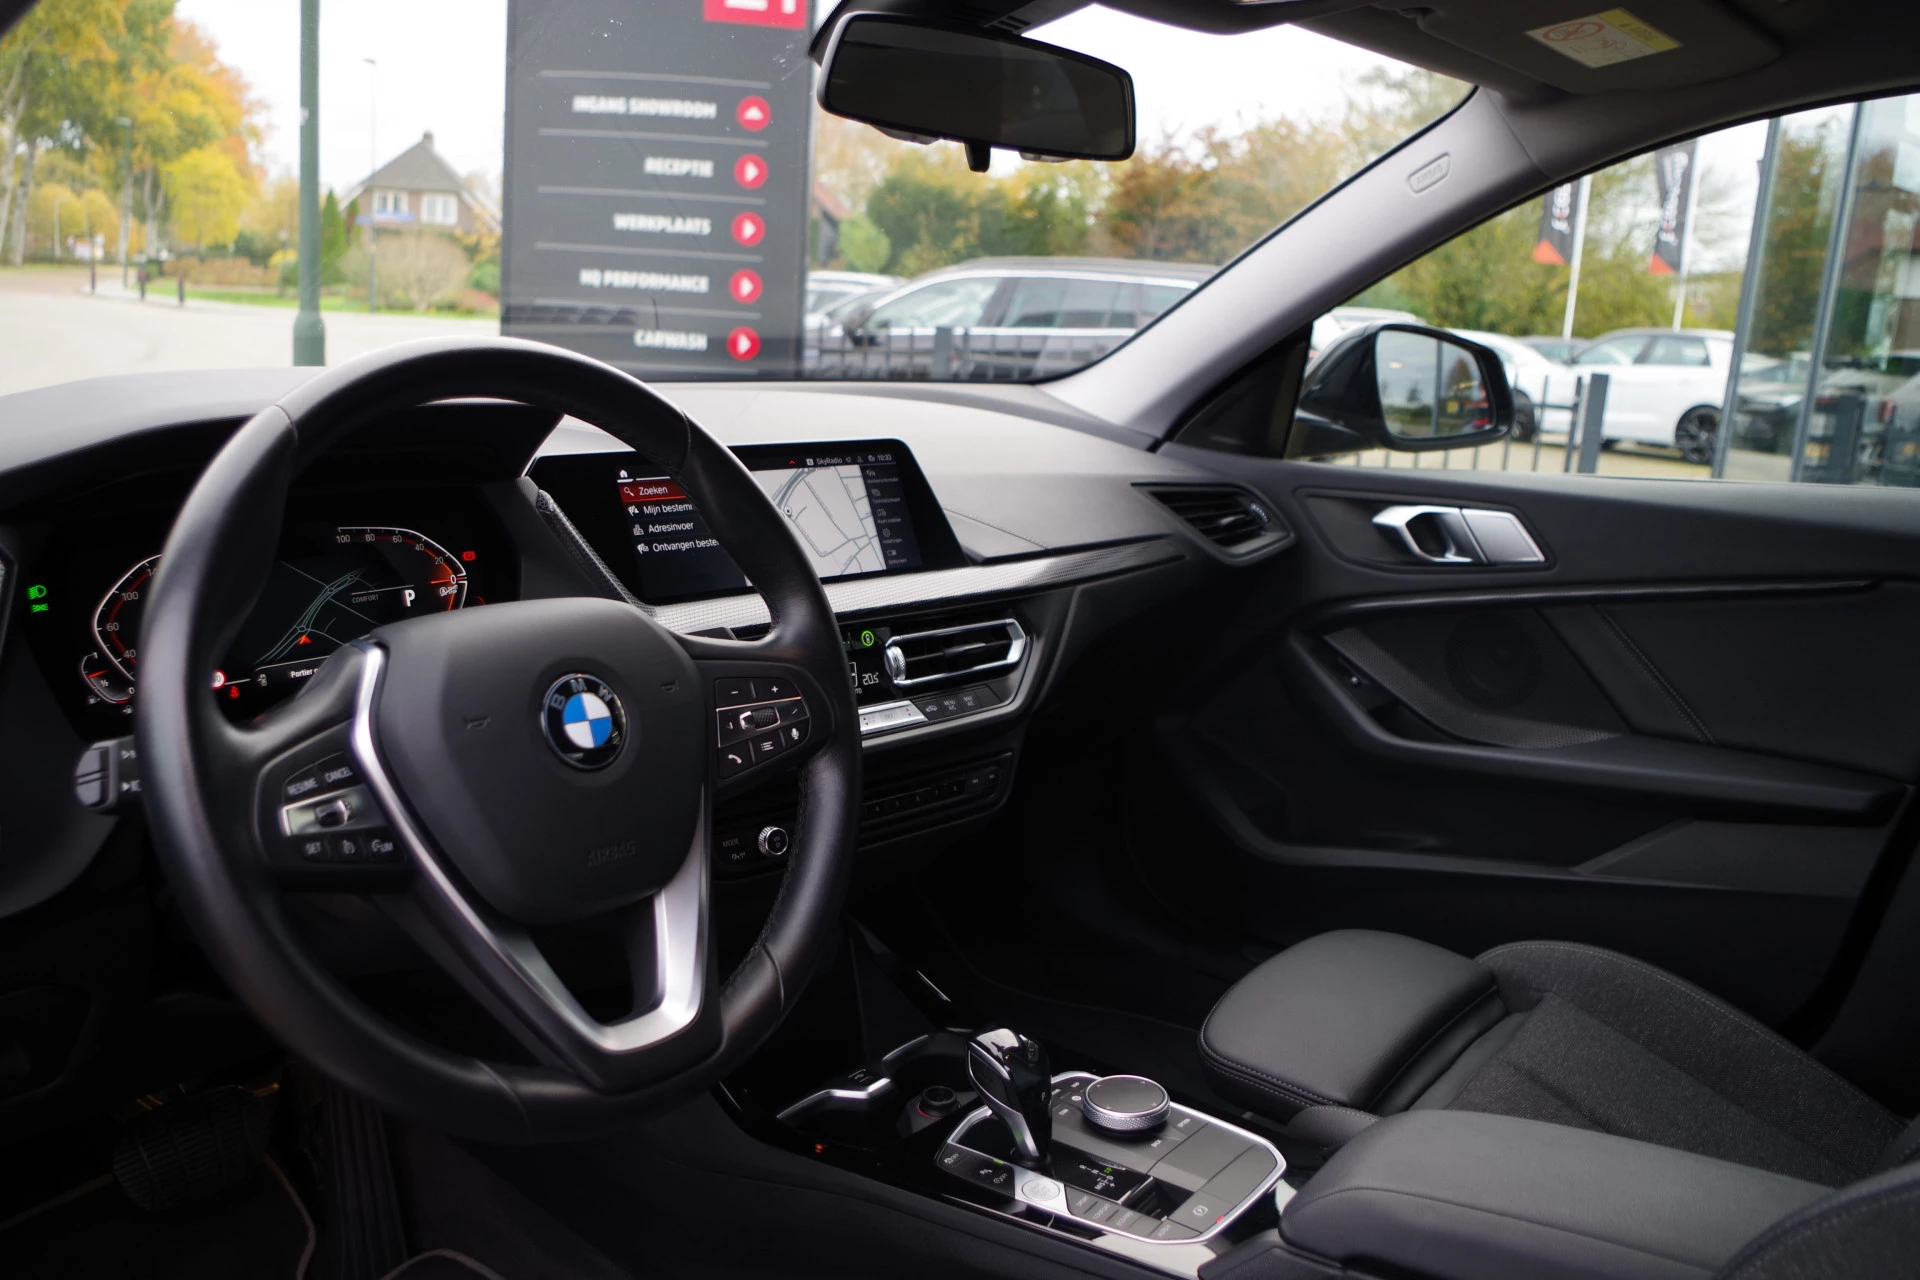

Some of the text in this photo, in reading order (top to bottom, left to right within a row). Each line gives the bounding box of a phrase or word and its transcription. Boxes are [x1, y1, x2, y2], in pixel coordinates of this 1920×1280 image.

[628, 97, 717, 119] SHOWROOM
[644, 157, 714, 178] RECEPTIE
[613, 213, 711, 235] WERKPLAATS
[579, 268, 709, 293] HQ PERFORMANCE
[633, 329, 708, 351] CARWASH
[638, 486, 668, 496] Zoeken
[643, 505, 661, 516] Mijn
[648, 522, 694, 533] Adresinvoer
[336, 534, 350, 543] 100
[365, 533, 376, 542] 80
[392, 535, 402, 543] 60
[415, 542, 425, 551] 40
[652, 541, 696, 552] Ontvangen
[434, 556, 444, 565] 20
[450, 574, 457, 584] 0
[121, 591, 139, 600] 100
[352, 594, 379, 604] COMFORT
[404, 589, 416, 607] P
[106, 622, 120, 632] 60
[124, 649, 136, 658] 40
[290, 669, 313, 678] Portier
[550, 679, 614, 710] BMW
[587, 840, 636, 868] AIRBAG
